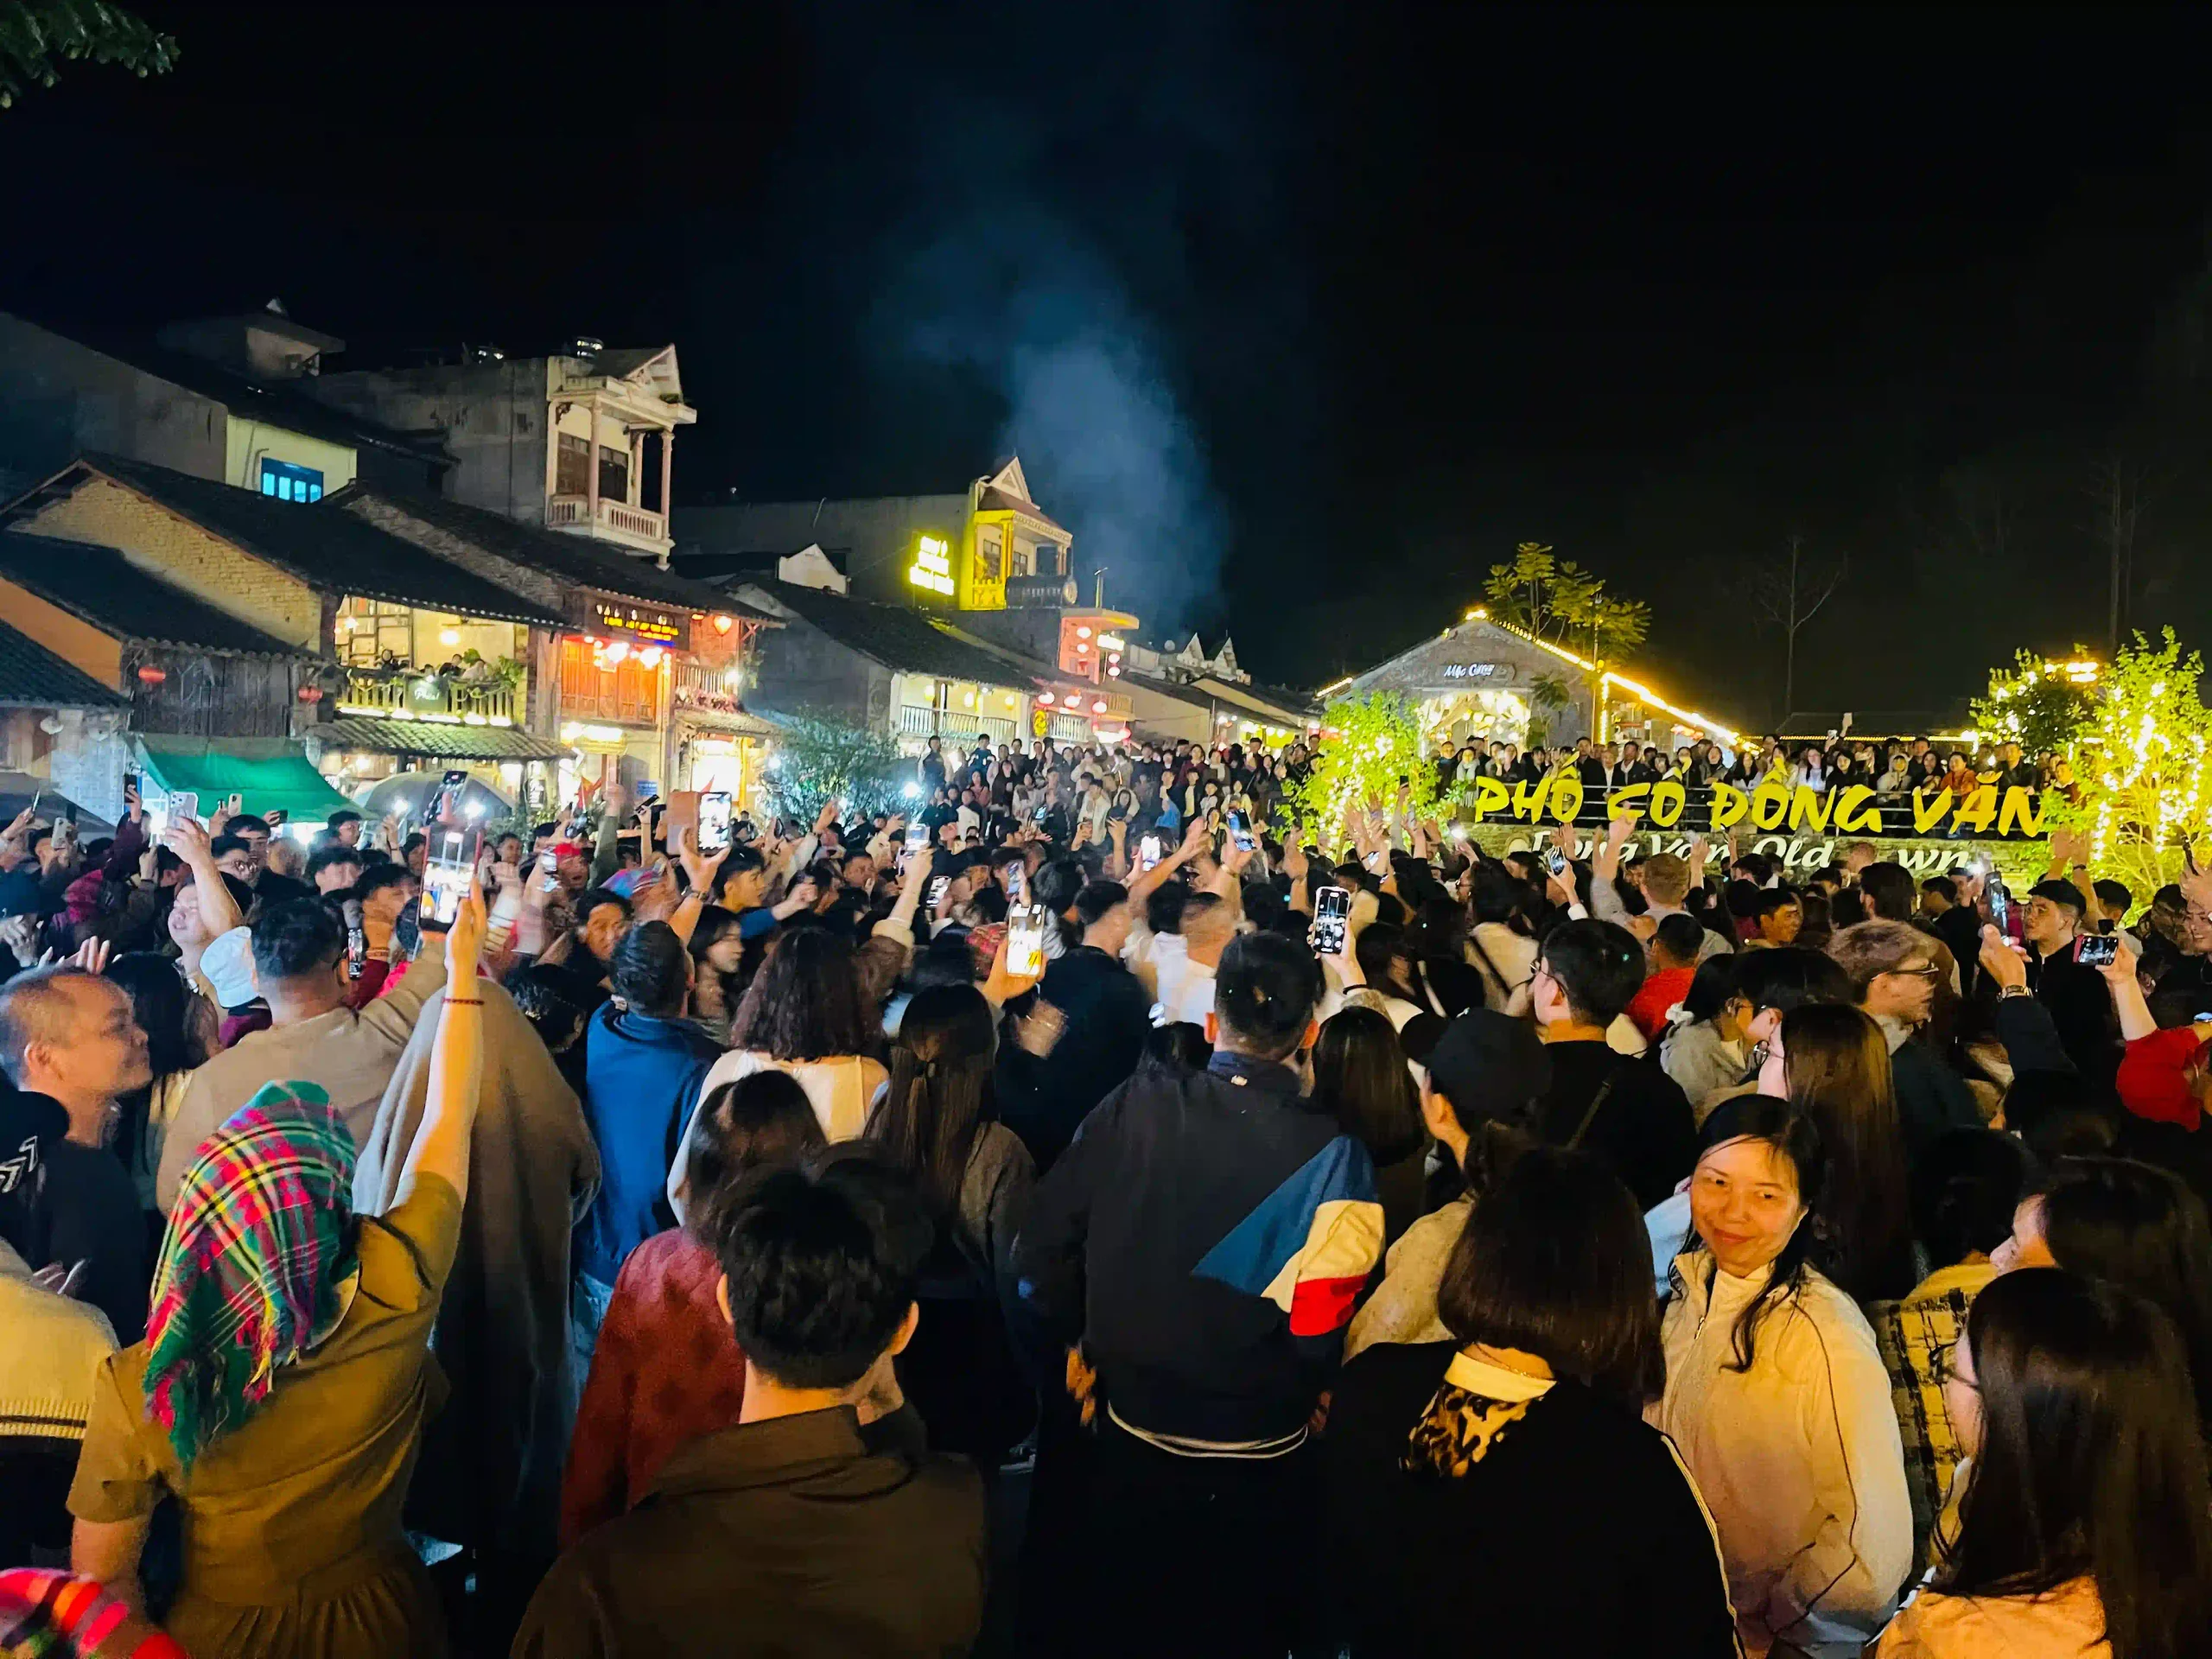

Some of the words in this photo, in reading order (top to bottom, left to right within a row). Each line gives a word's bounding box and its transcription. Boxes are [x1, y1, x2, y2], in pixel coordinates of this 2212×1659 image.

[1474, 750, 1584, 824] PHỐ
[1707, 756, 1883, 833] ĐỒNG
[1911, 771, 2046, 838] VĂN
[1752, 836, 1835, 868] Old
